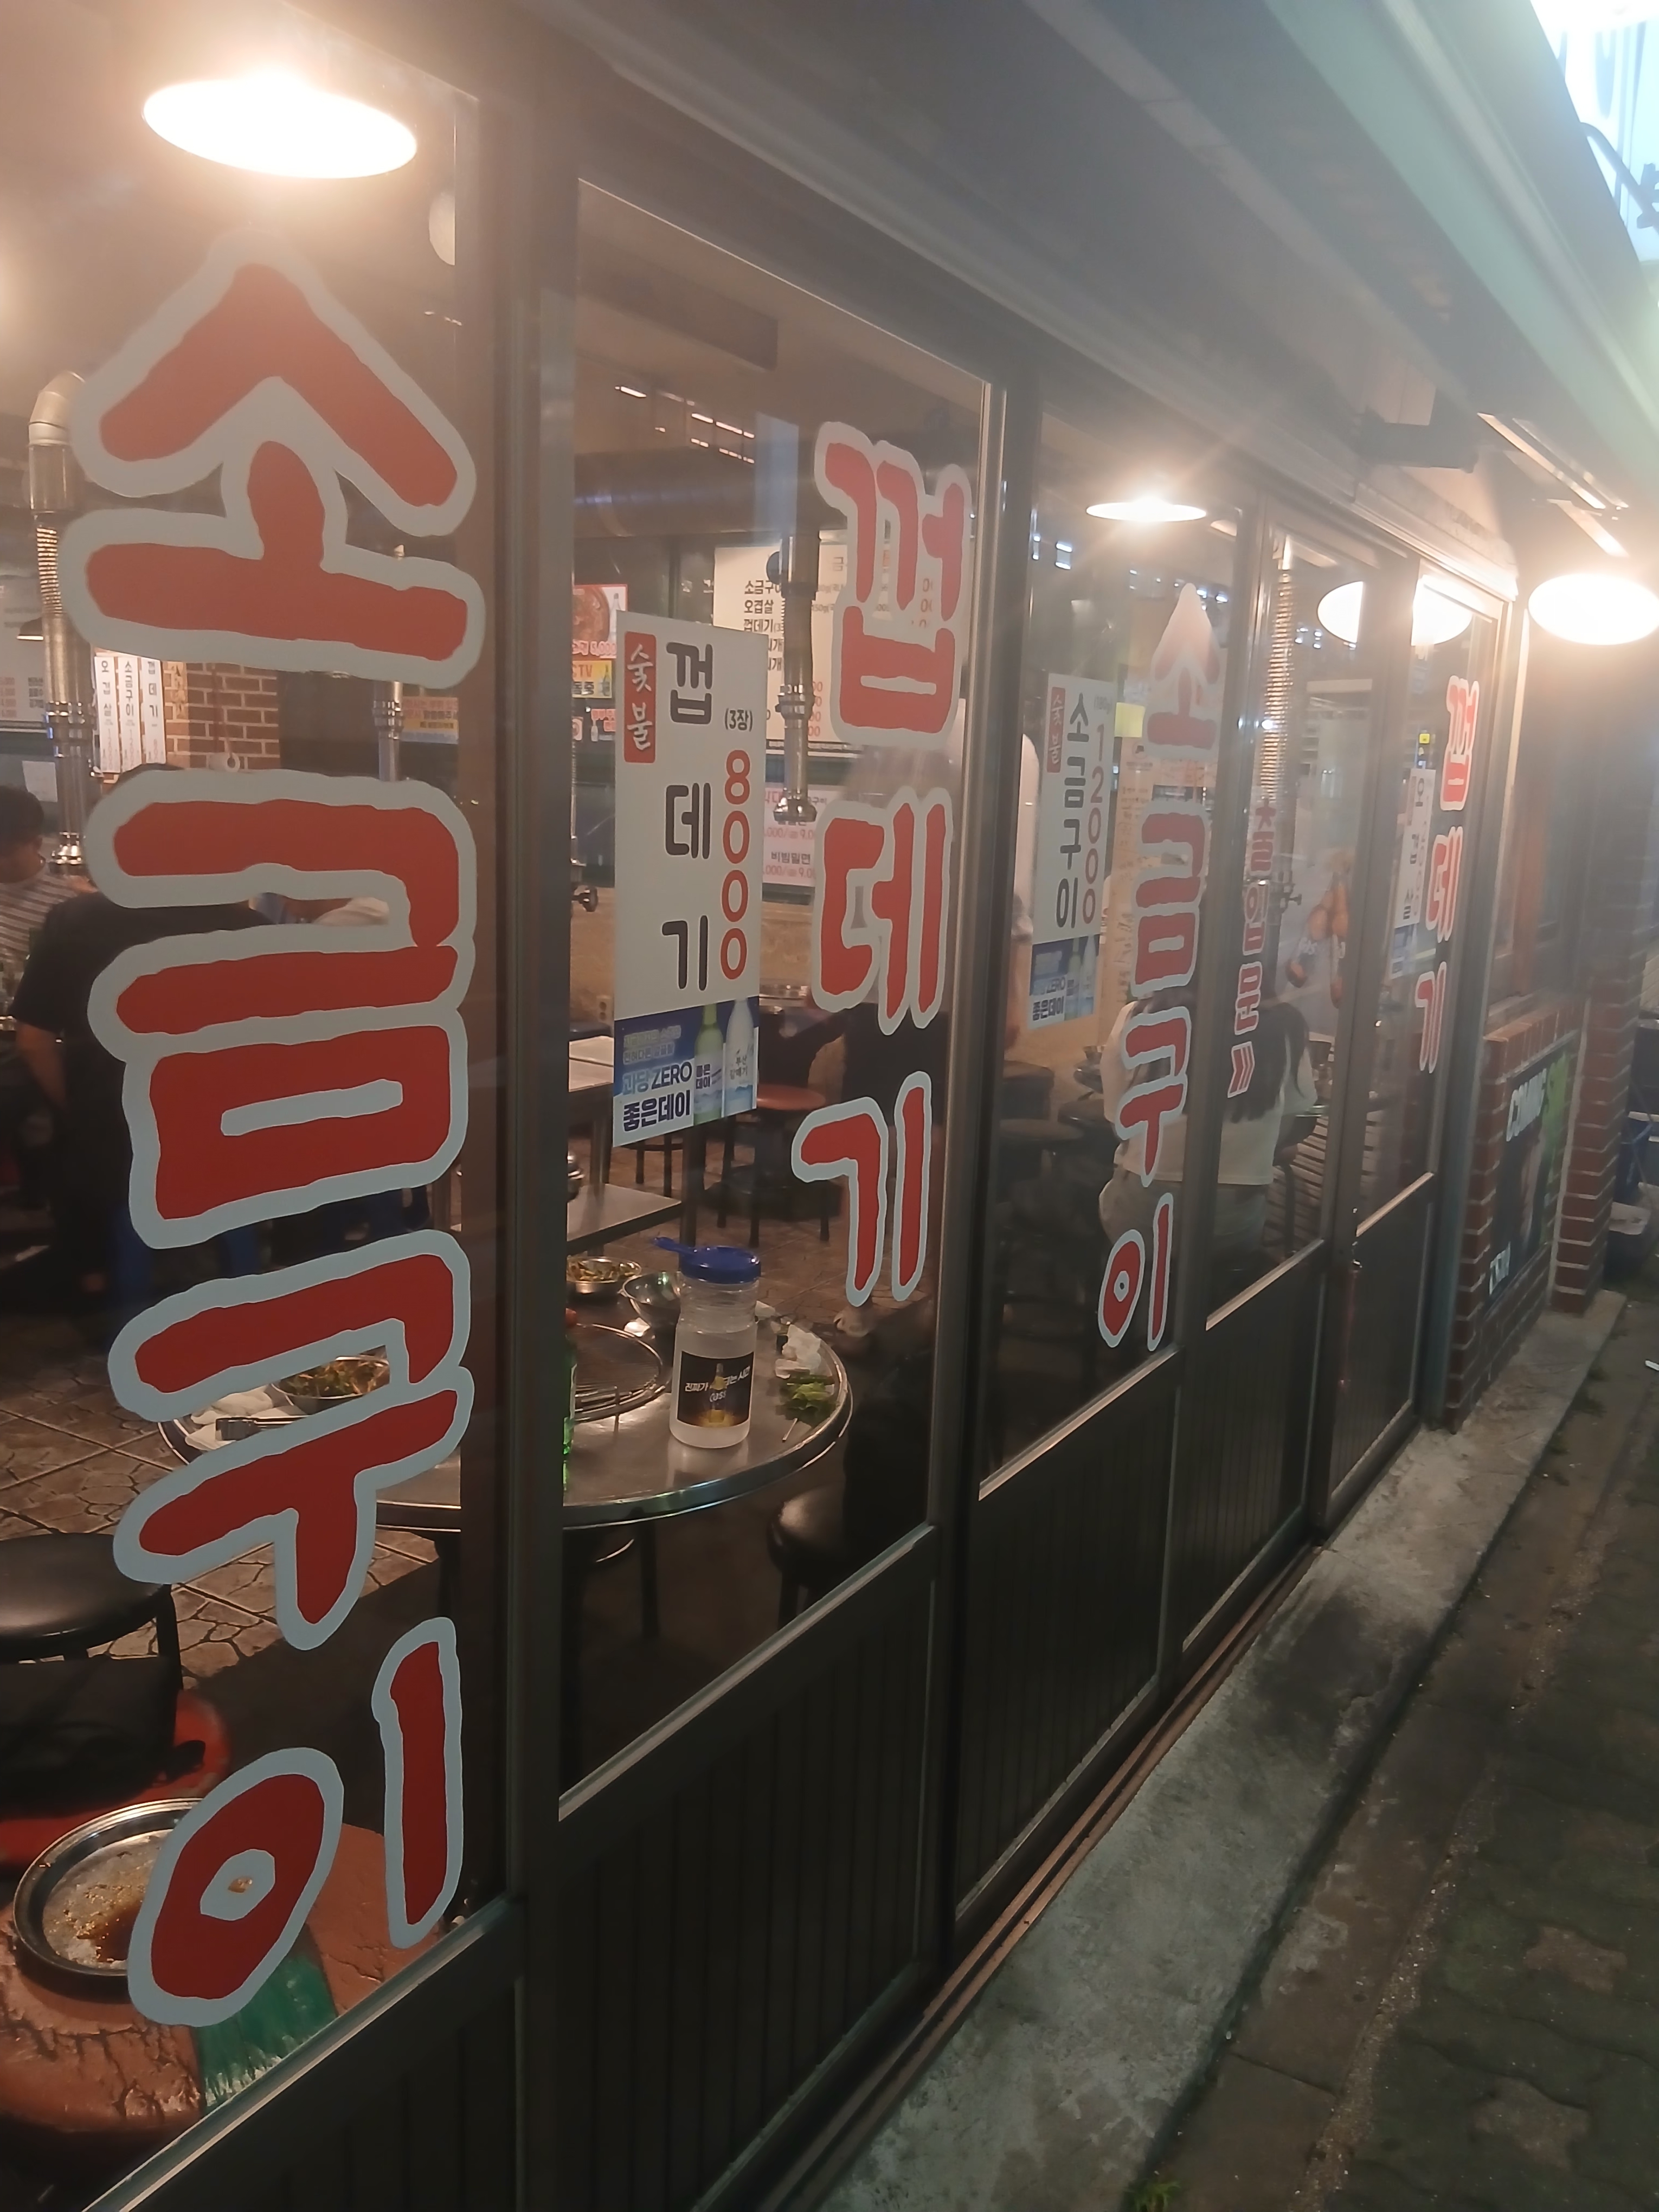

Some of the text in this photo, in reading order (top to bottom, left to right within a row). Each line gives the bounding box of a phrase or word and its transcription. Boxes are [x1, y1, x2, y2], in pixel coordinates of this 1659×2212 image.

[124, 660, 134, 717] 소금구이
[627, 643, 654, 750] 숯불
[724, 708, 753, 732] (3장)
[744, 599, 774, 614] 오겹살
[662, 642, 712, 991] 껍데기
[720, 749, 750, 980] 8000
[790, 420, 972, 1308] 껍데기
[1056, 692, 1090, 928] 소금구이
[1082, 723, 1104, 924] 12000
[1234, 798, 1276, 1036] 출입문
[1416, 676, 1480, 1074] 껍데기
[651, 1061, 692, 1090] ZERO
[1097, 583, 1222, 1351] 소금구이
[61, 230, 487, 2029] 소금구이
[623, 1089, 691, 1132] 좋은데이
